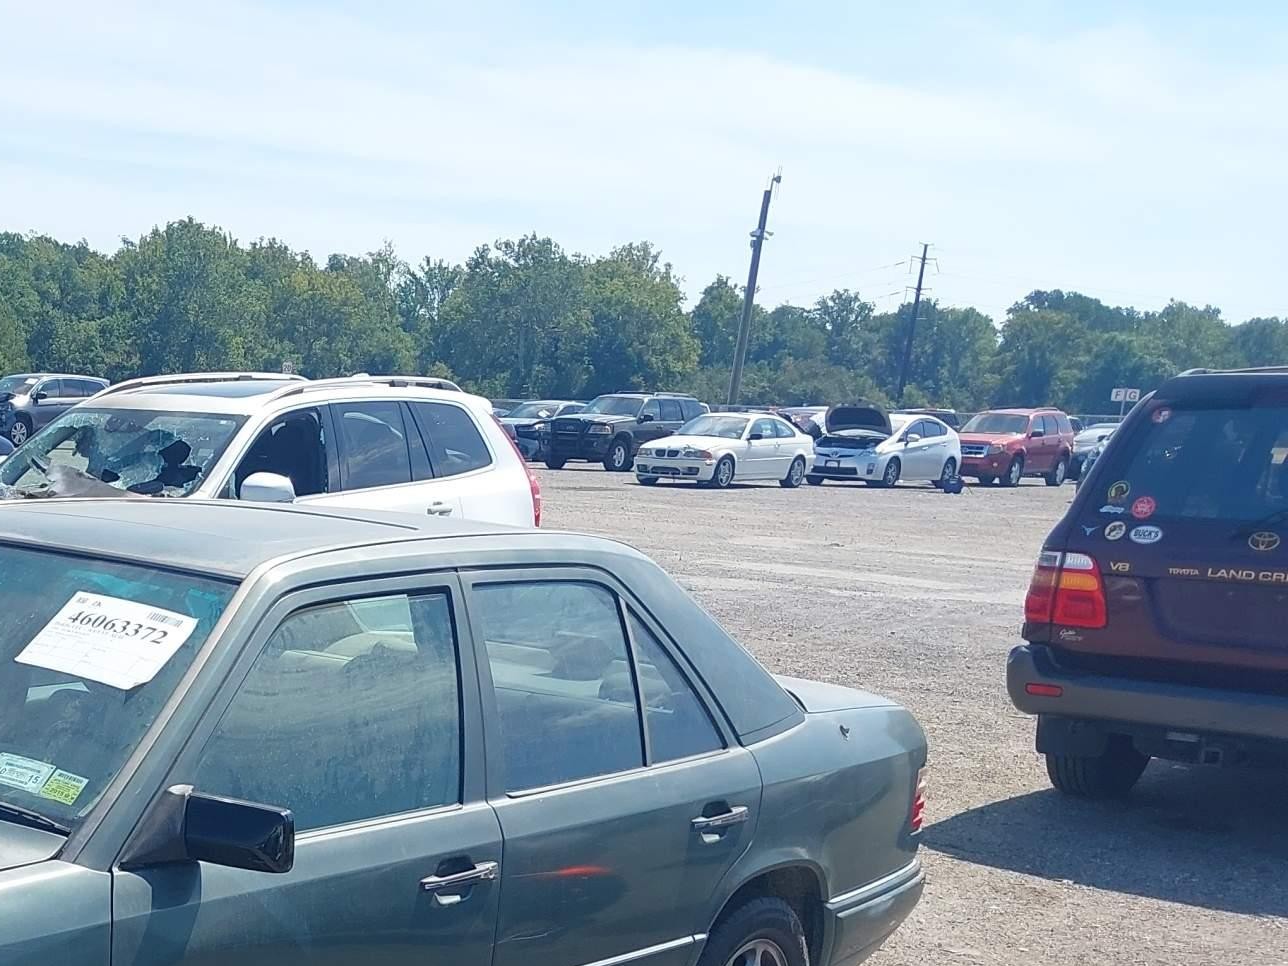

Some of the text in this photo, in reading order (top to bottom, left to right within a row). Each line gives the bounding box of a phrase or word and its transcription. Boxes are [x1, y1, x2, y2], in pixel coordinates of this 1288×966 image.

[1114, 390, 1123, 400] F
[1128, 390, 1137, 400] G
[1110, 561, 1130, 572] V8
[1168, 567, 1288, 582] TOYOTA LAND CR
[68, 610, 169, 645] 46063372
[27, 774, 40, 784] 15
